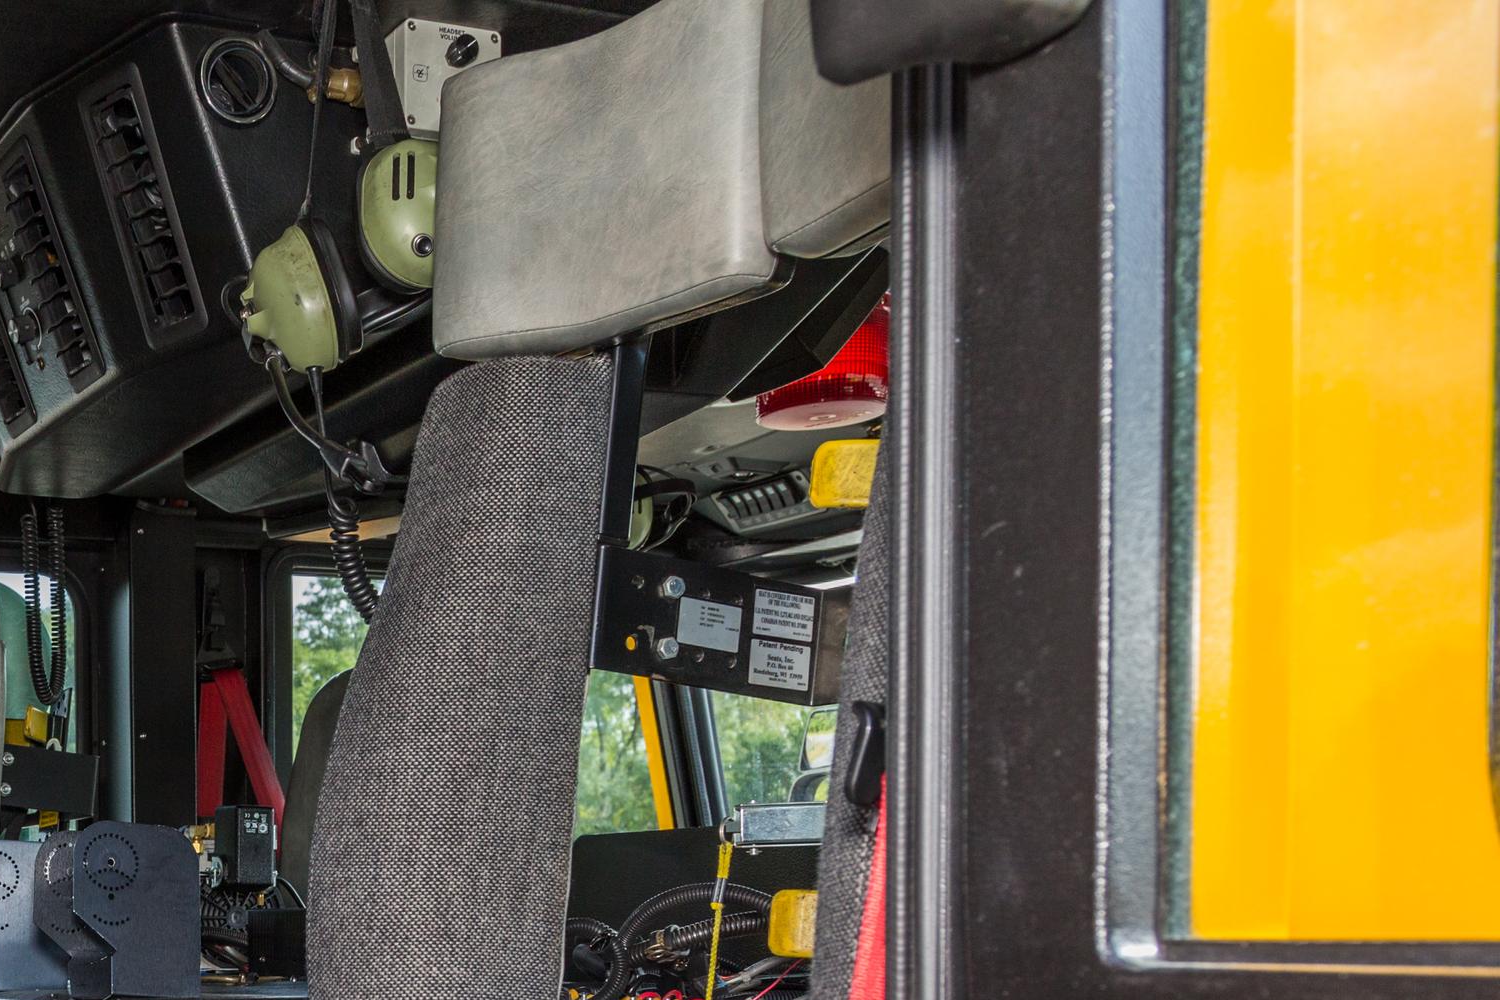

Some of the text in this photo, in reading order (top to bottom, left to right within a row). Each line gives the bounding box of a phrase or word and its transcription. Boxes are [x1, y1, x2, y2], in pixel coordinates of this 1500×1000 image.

[439, 27, 465, 35] HEADSET
[758, 640, 803, 654] Patent Pending
